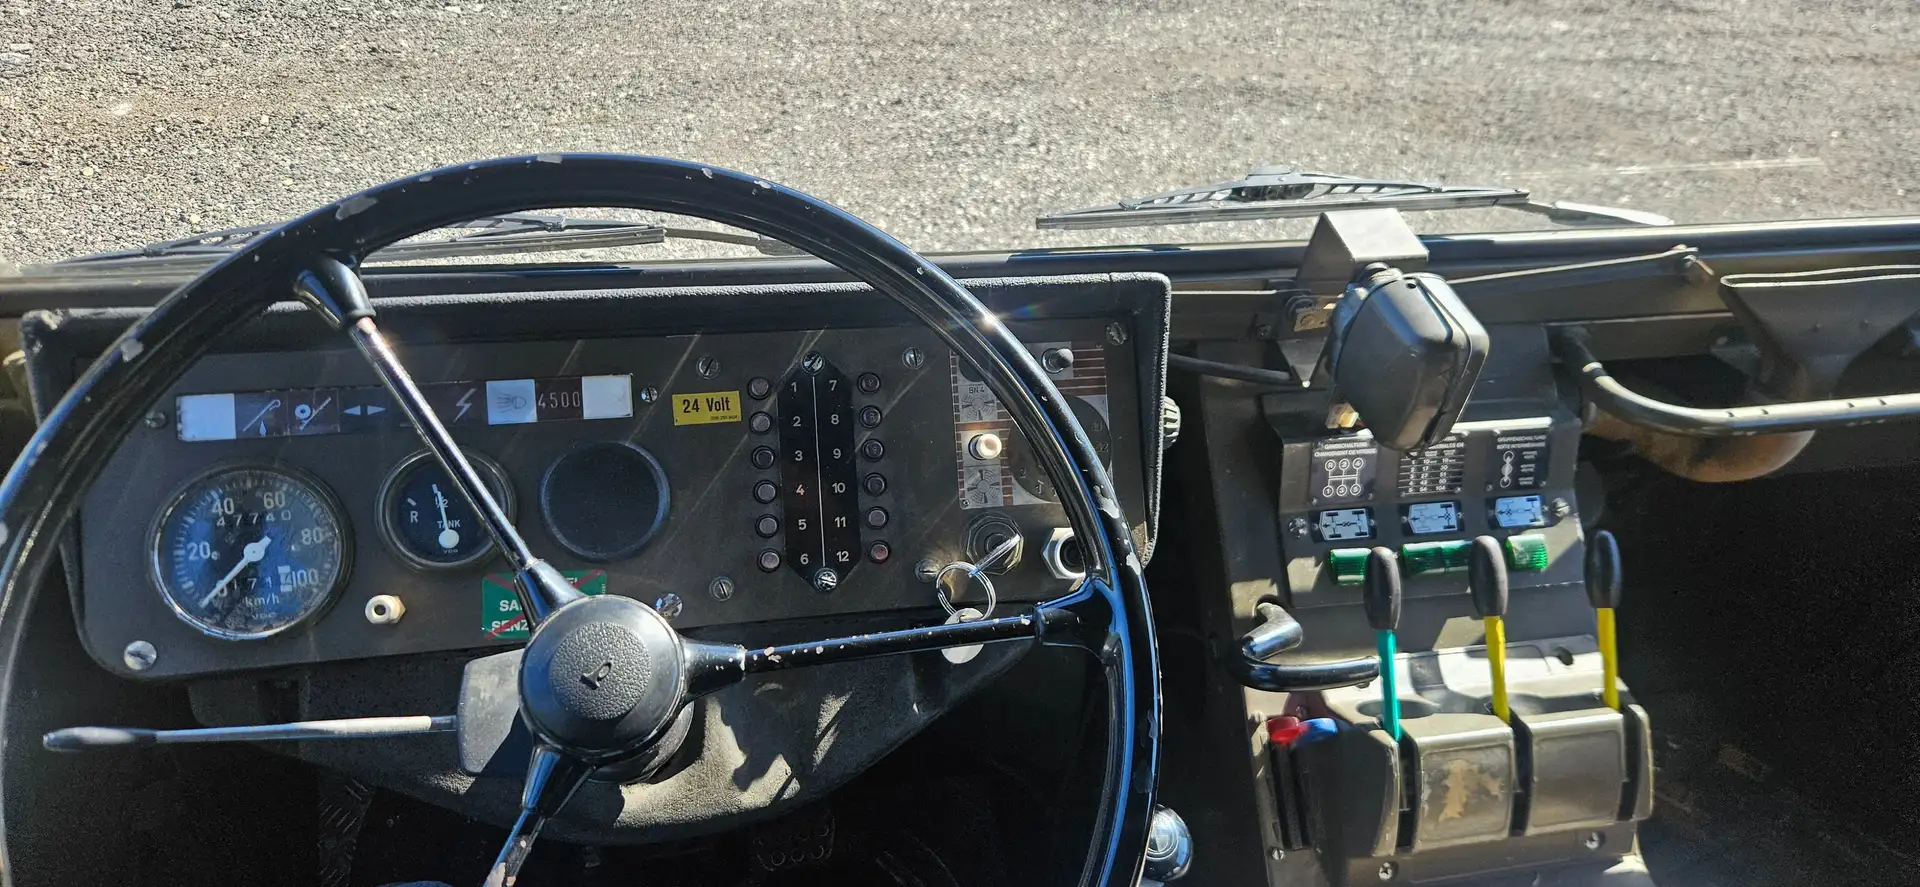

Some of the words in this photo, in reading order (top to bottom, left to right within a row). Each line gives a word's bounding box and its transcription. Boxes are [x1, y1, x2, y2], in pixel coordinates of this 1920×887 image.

[791, 382, 797, 392] 1
[829, 380, 838, 391] 7
[538, 391, 581, 409] 4500
[682, 398, 700, 413] 24
[706, 396, 731, 412] Volt
[793, 416, 801, 427] 2
[831, 414, 840, 425] 8
[795, 450, 803, 461] 3
[833, 448, 841, 460] 9
[796, 485, 805, 496] 4
[832, 483, 846, 494] 10
[263, 492, 286, 509] 60
[212, 498, 234, 515] 40
[410, 511, 418, 523] R
[835, 517, 847, 528] 11
[799, 520, 807, 531] 5
[301, 528, 325, 545] 80
[187, 542, 211, 560] 20
[836, 551, 850, 562] 12
[800, 554, 809, 565] 6
[292, 567, 320, 589] 100
[245, 593, 280, 606] km/h
